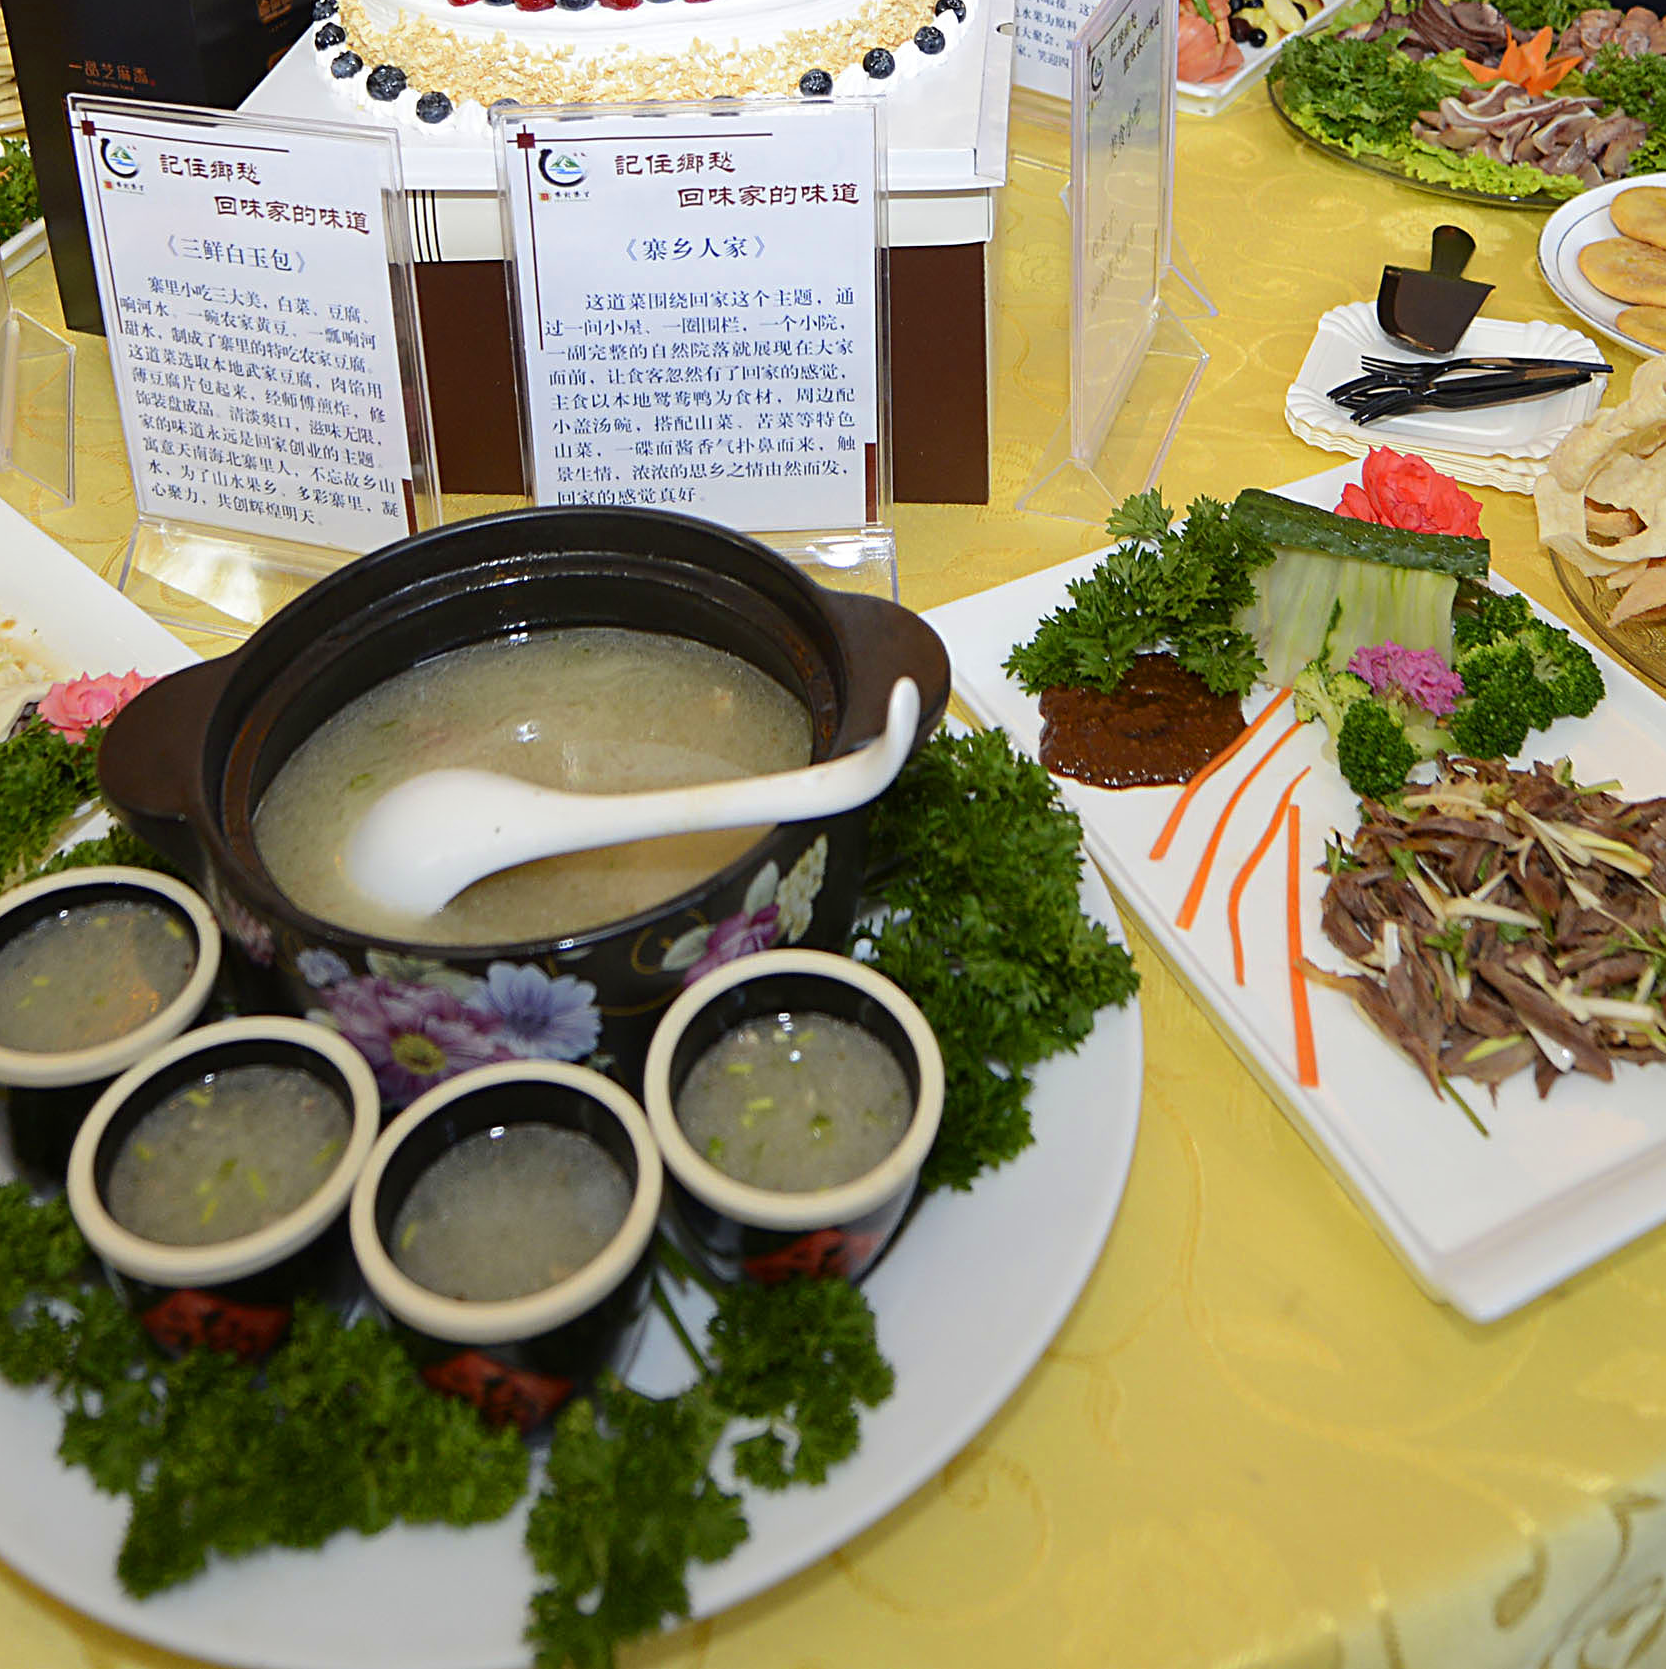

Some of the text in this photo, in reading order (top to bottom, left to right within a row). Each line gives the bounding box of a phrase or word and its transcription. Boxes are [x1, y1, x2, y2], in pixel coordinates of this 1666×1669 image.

[677, 183, 860, 208] 回味家的味道
[213, 195, 370, 234] 回味家的味道
[167, 234, 308, 274] 《三鲜白玉包》
[624, 234, 766, 262] 《寨乡人家》
